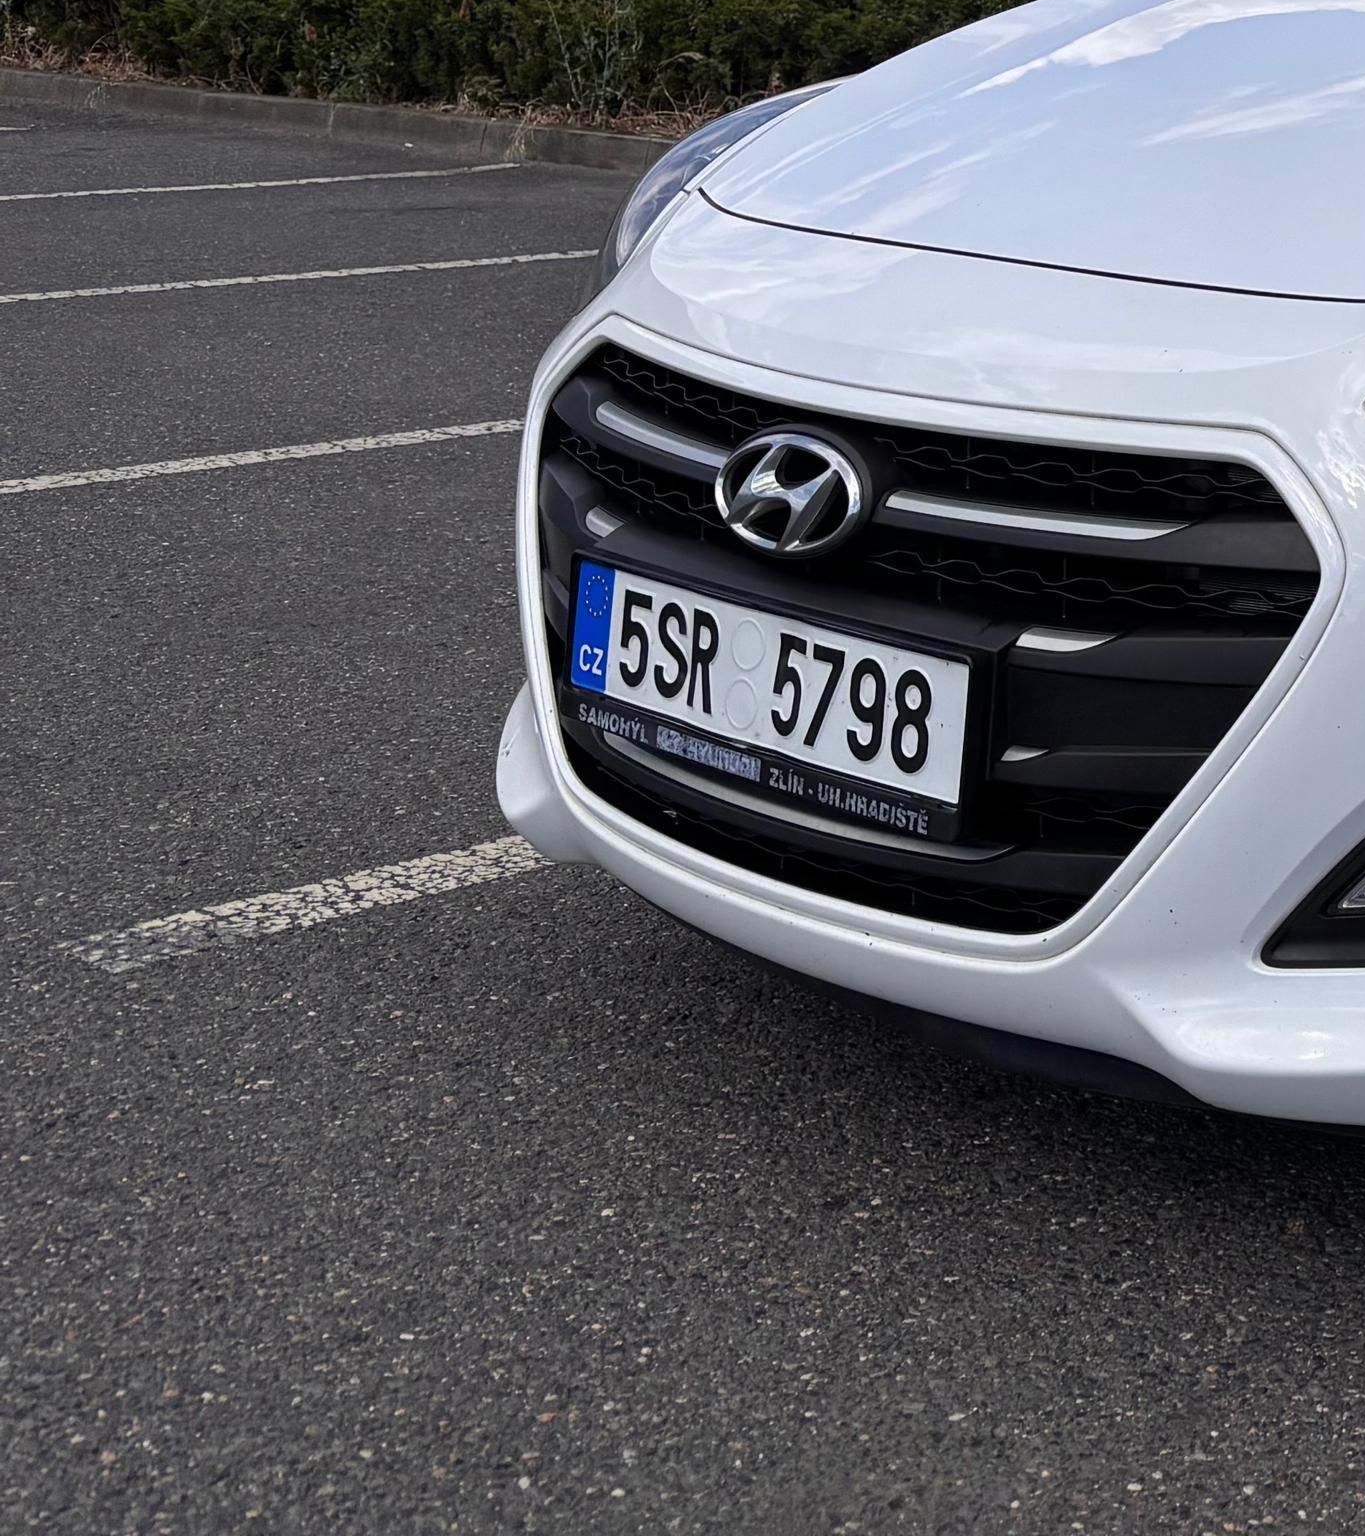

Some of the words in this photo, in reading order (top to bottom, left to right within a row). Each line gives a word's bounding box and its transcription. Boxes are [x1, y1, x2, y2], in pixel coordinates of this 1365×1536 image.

[579, 643, 604, 676] CZ
[619, 589, 719, 715] 5SR
[771, 632, 932, 774] 5798
[578, 703, 648, 744] SAMOHÝL
[769, 768, 804, 796] ZLÍN
